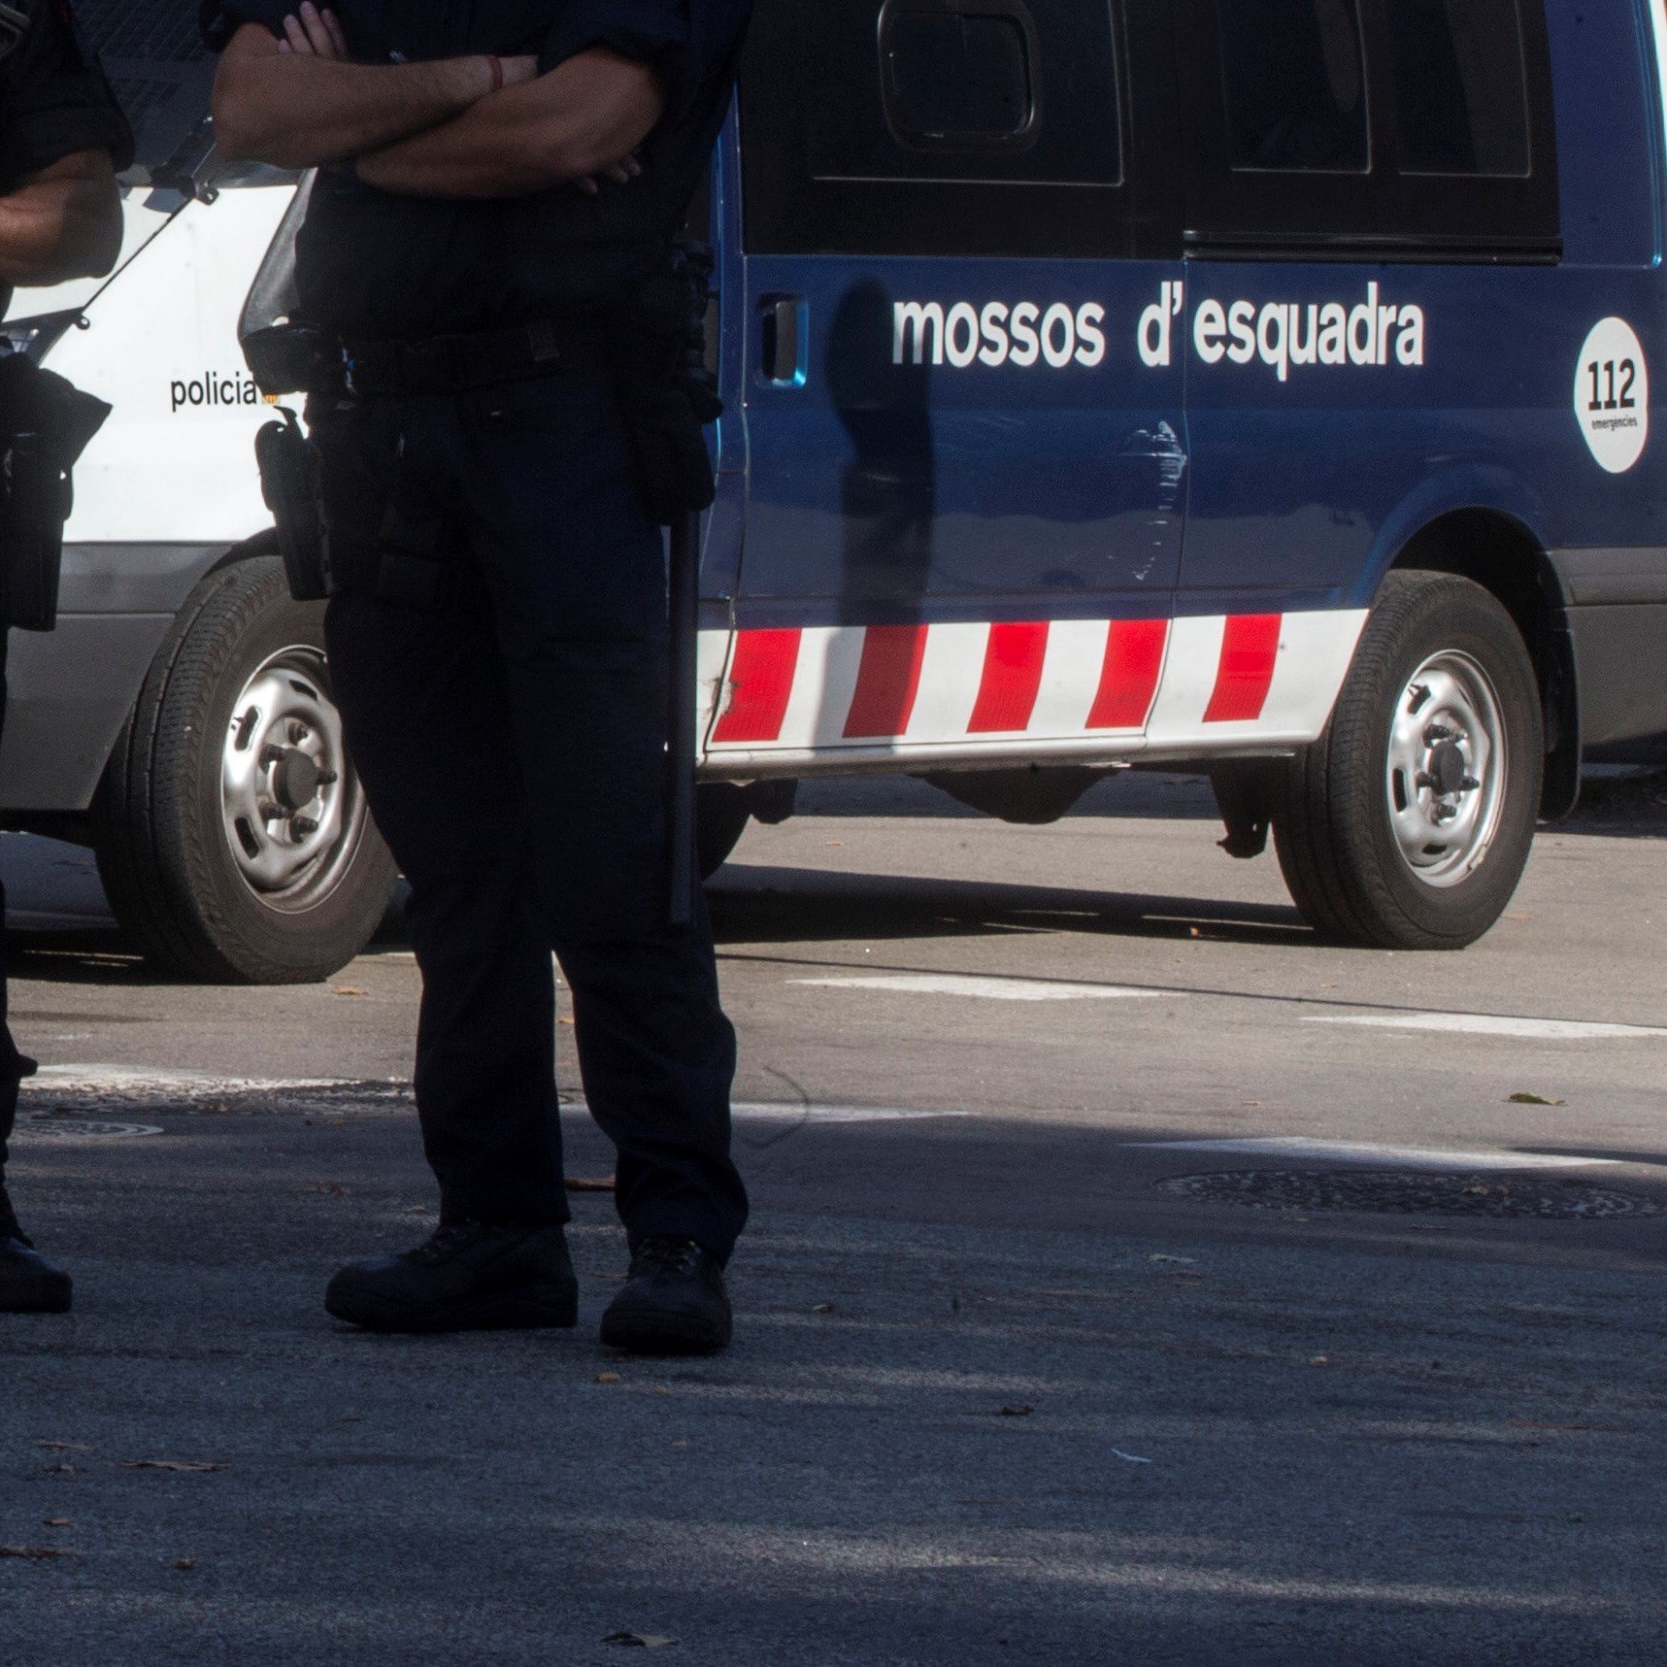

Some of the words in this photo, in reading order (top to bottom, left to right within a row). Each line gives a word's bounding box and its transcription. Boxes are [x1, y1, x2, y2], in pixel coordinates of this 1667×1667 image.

[893, 300, 1105, 367] mossos
[1193, 280, 1424, 381] esquadra
[170, 370, 257, 413] policia
[1587, 357, 1635, 411] 112
